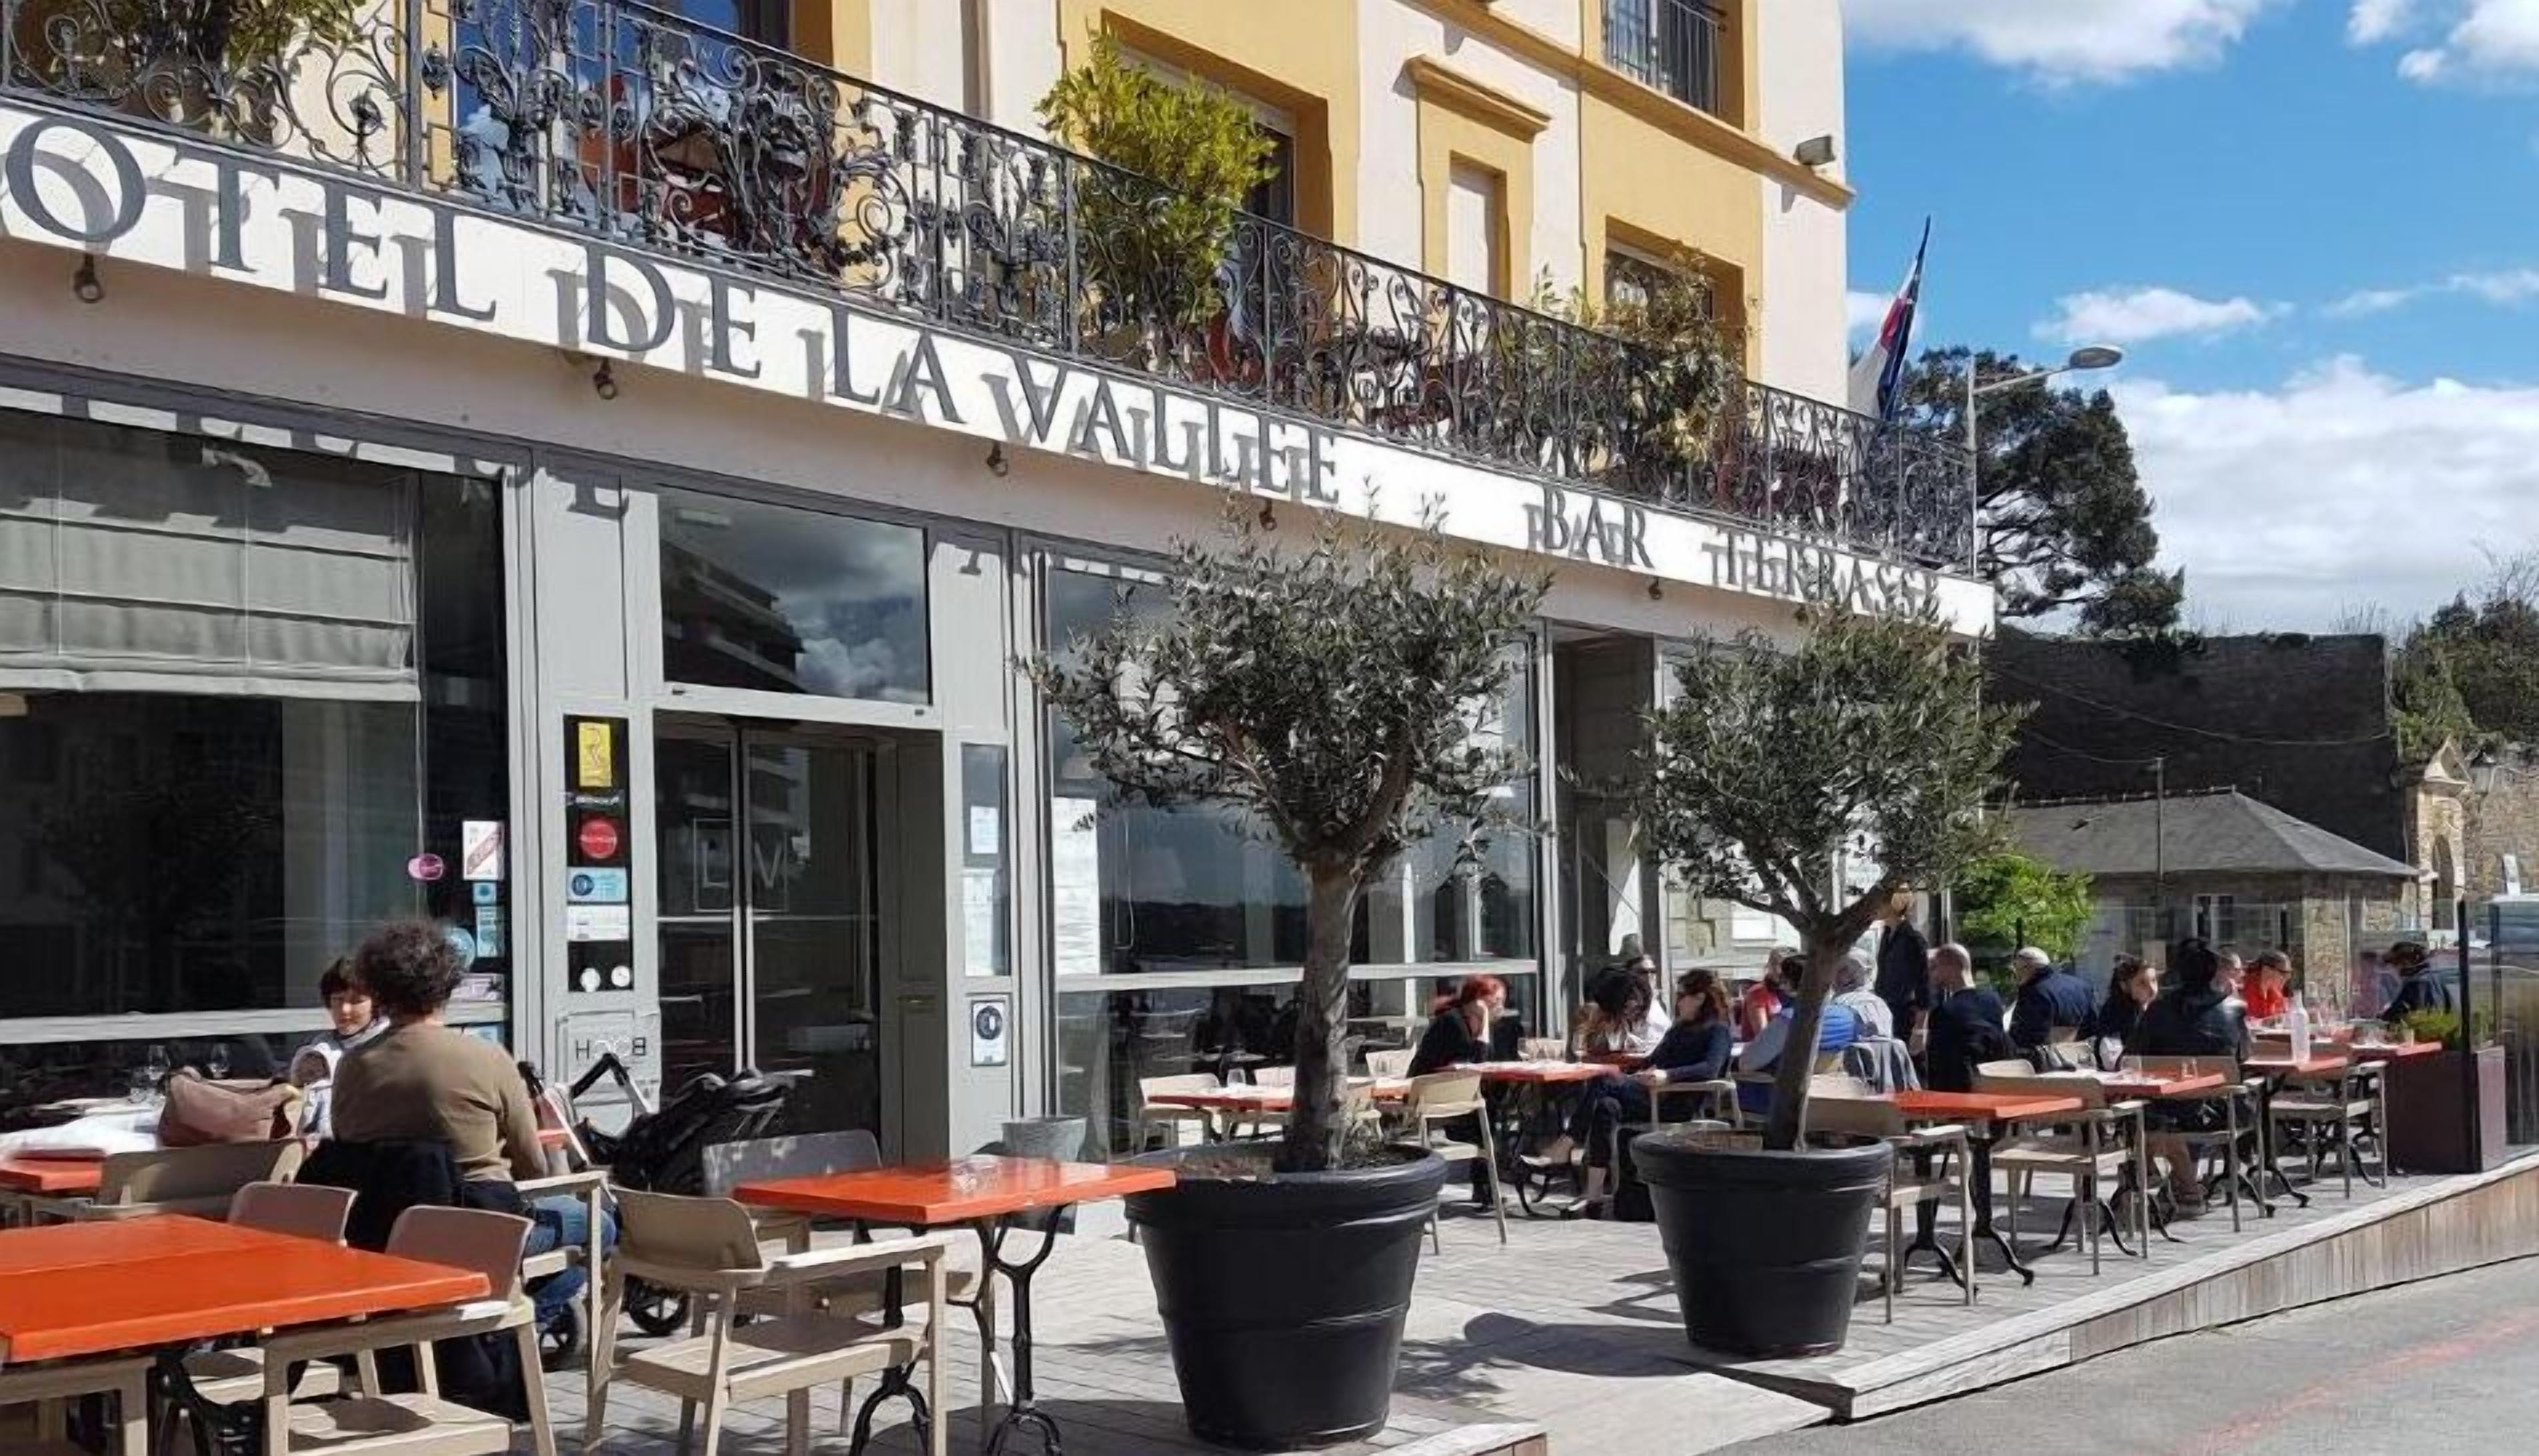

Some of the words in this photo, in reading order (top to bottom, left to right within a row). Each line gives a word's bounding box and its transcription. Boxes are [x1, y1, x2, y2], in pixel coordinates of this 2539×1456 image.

[581, 244, 761, 379] DE
[825, 304, 967, 424] LA
[1541, 483, 1656, 569] BAR
